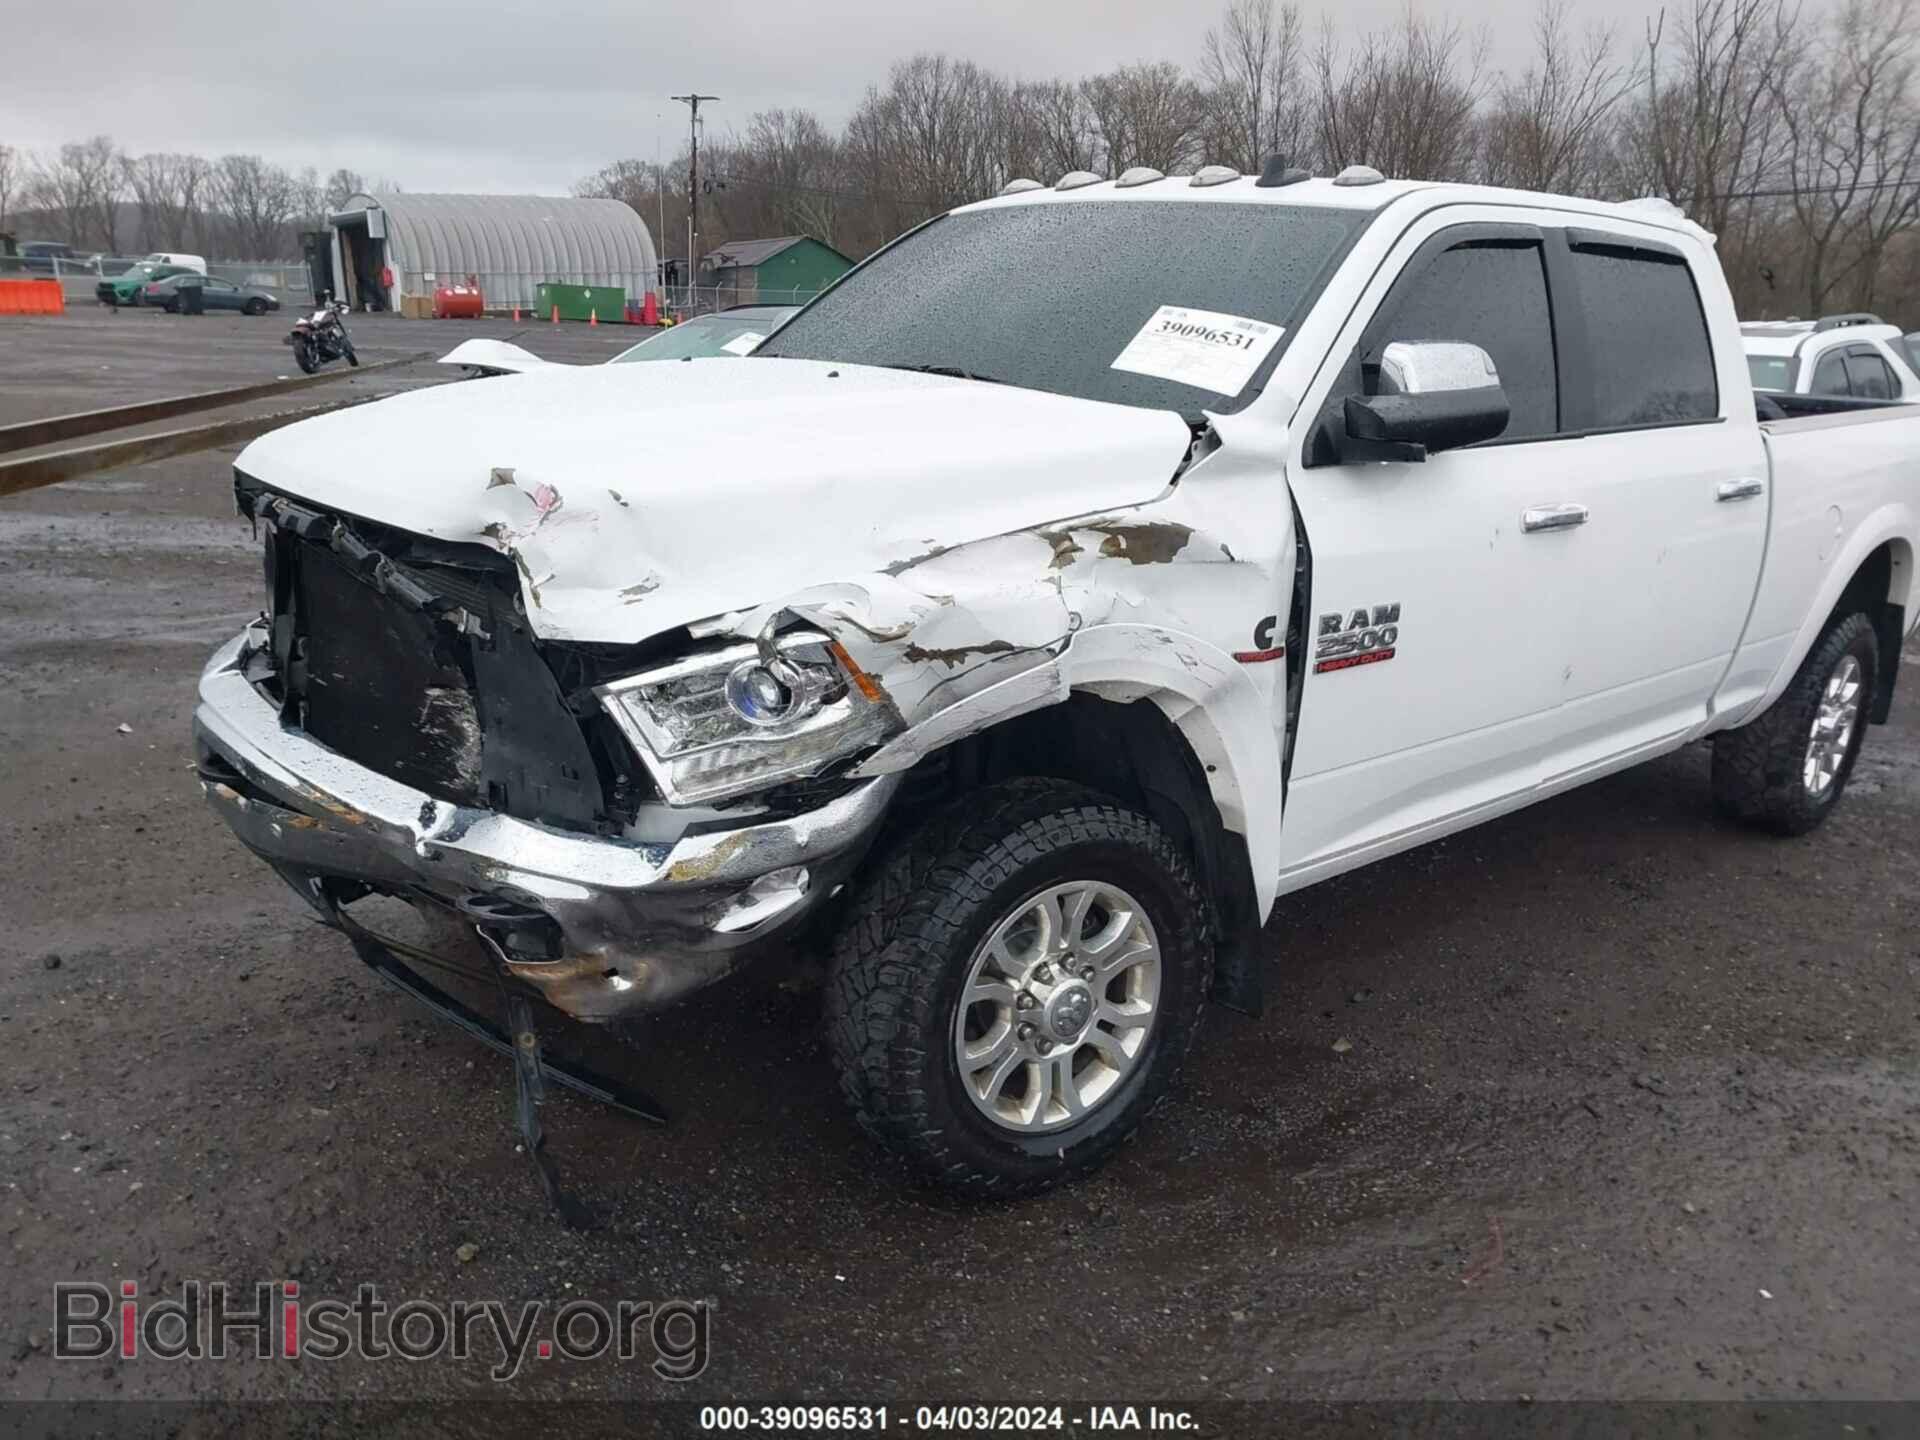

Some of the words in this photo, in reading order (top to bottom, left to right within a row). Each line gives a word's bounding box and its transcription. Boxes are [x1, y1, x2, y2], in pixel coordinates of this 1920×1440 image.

[1155, 319, 1256, 350] 39096531
[1319, 602, 1401, 636] RAM
[1316, 624, 1398, 659] 2500
[1319, 655, 1360, 673] HEAVY
[1361, 648, 1394, 665] DUTY
